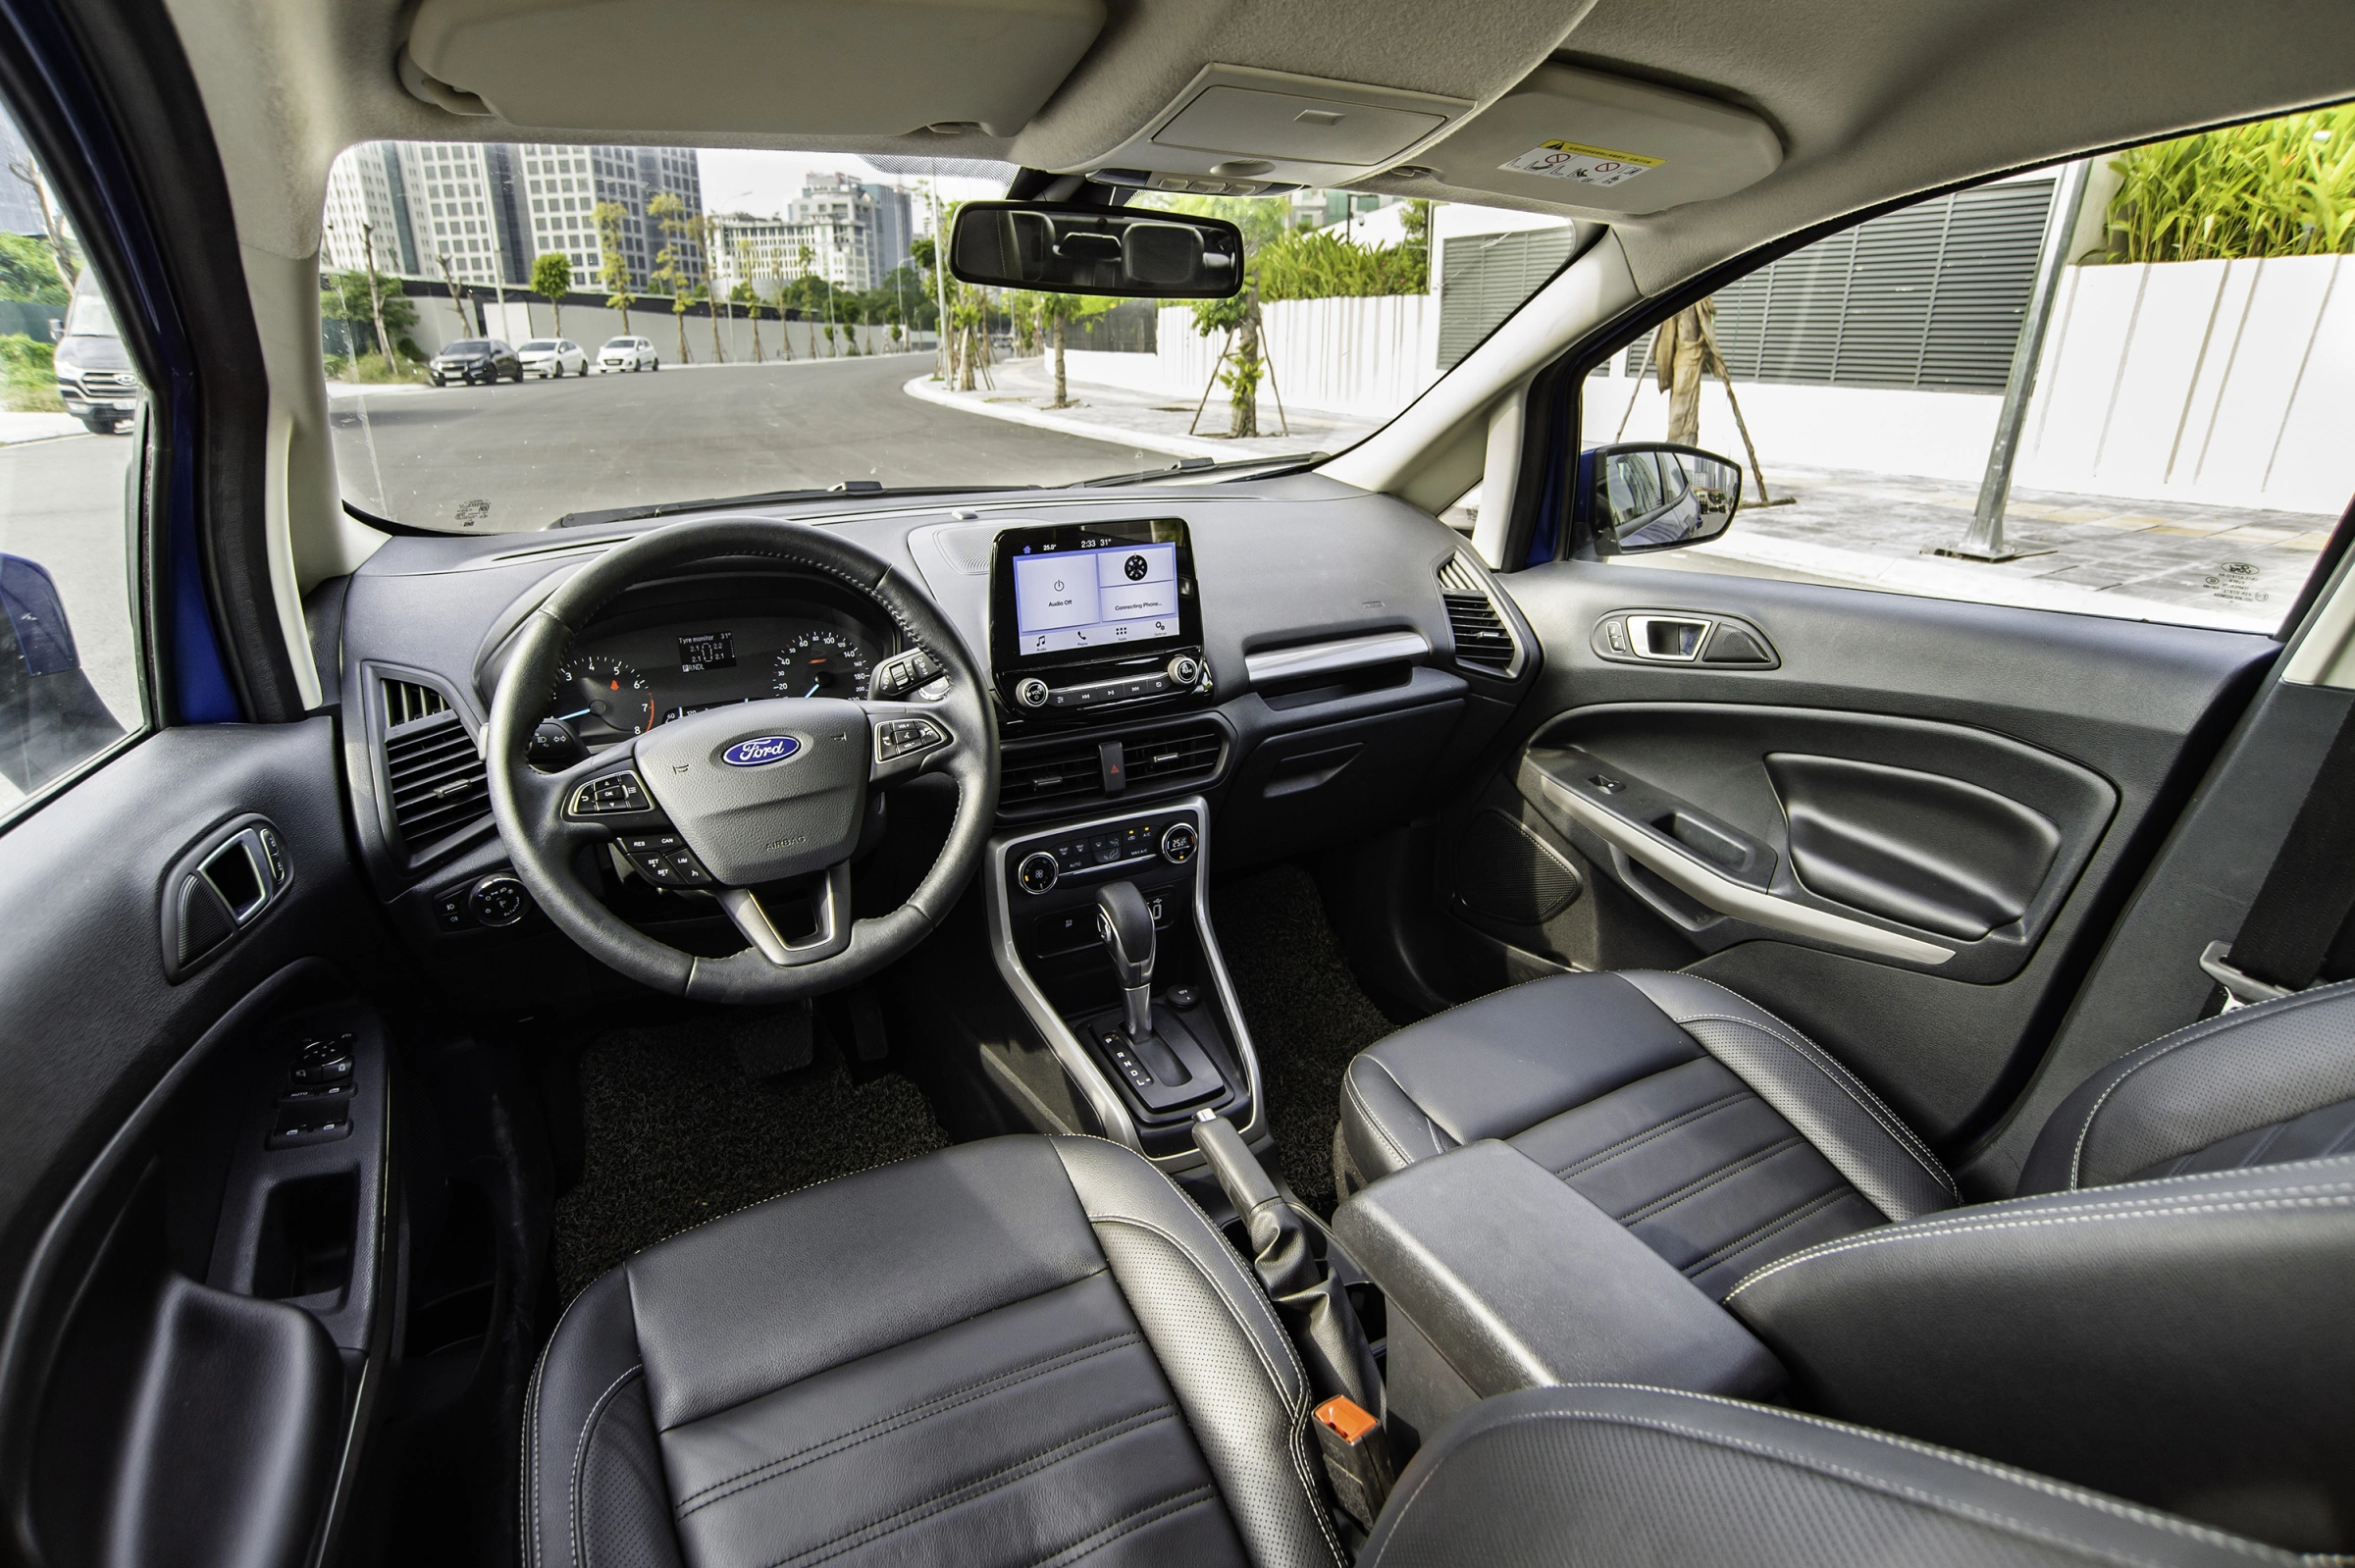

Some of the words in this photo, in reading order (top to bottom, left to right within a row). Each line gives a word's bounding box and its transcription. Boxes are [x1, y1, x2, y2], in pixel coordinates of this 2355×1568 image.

[1080, 540, 1096, 549] 2:33
[1115, 602, 1143, 611] Connecting
[589, 662, 595, 671] 4
[613, 666, 620, 676] 5
[565, 672, 573, 681] 3
[634, 680, 641, 690] 6
[641, 704, 649, 712] 7
[634, 726, 641, 735] 8
[739, 739, 785, 761] Ford
[765, 835, 806, 852] AIRBAG
